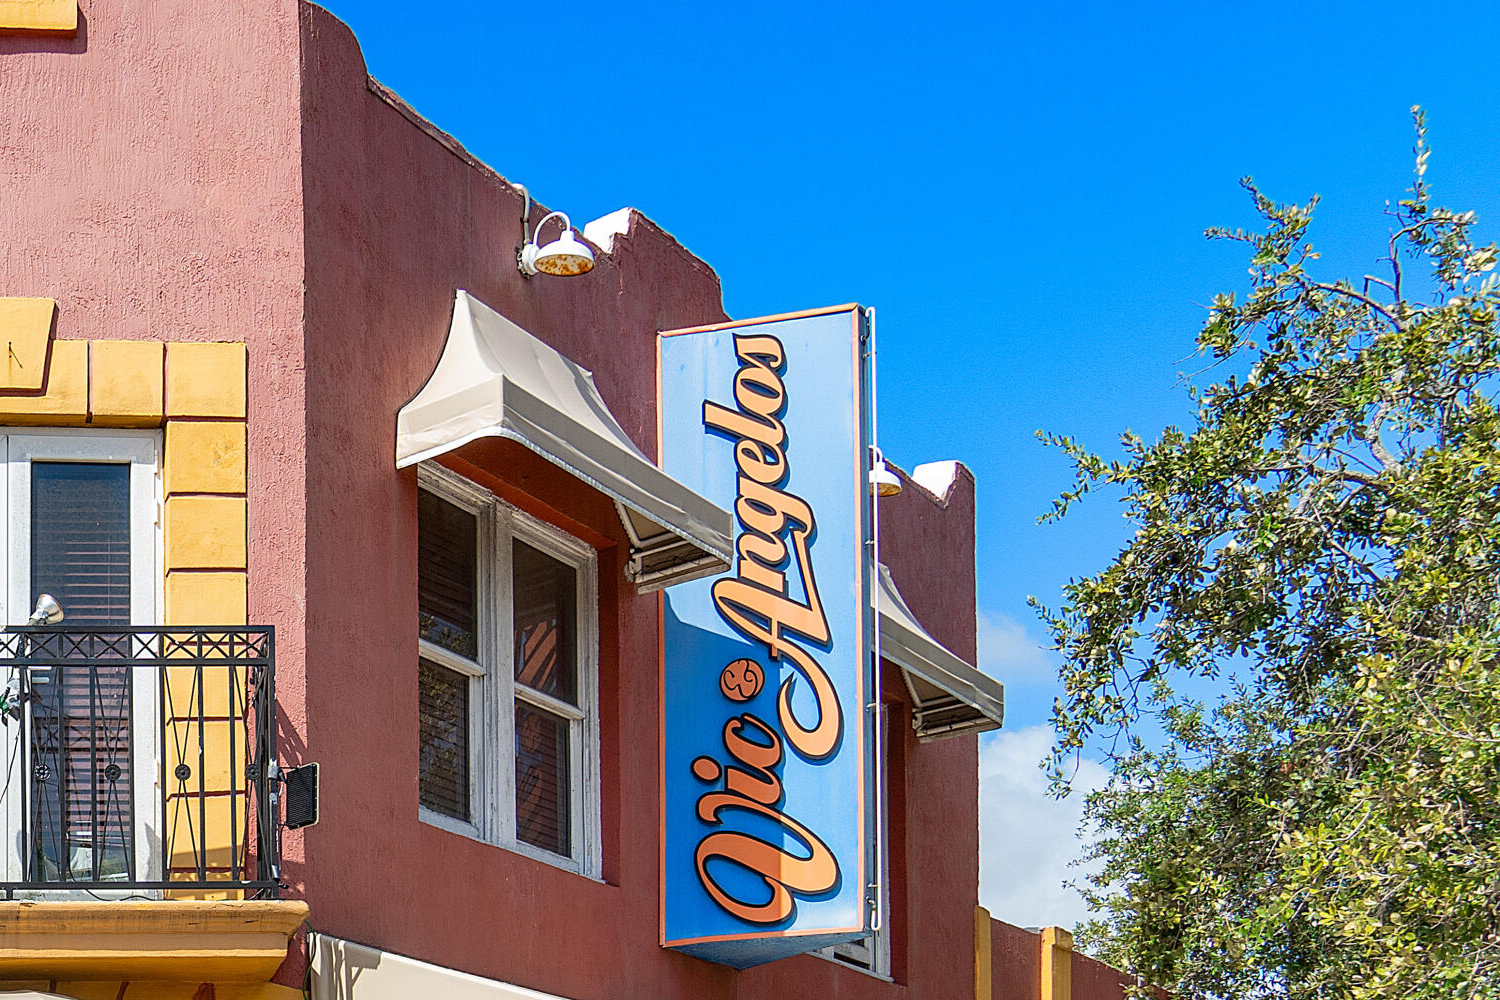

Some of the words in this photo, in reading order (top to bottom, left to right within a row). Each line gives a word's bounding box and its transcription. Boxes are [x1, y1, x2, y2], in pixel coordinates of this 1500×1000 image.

[701, 332, 844, 765] Angelos
[719, 656, 765, 702] &
[690, 712, 842, 927] Vic
